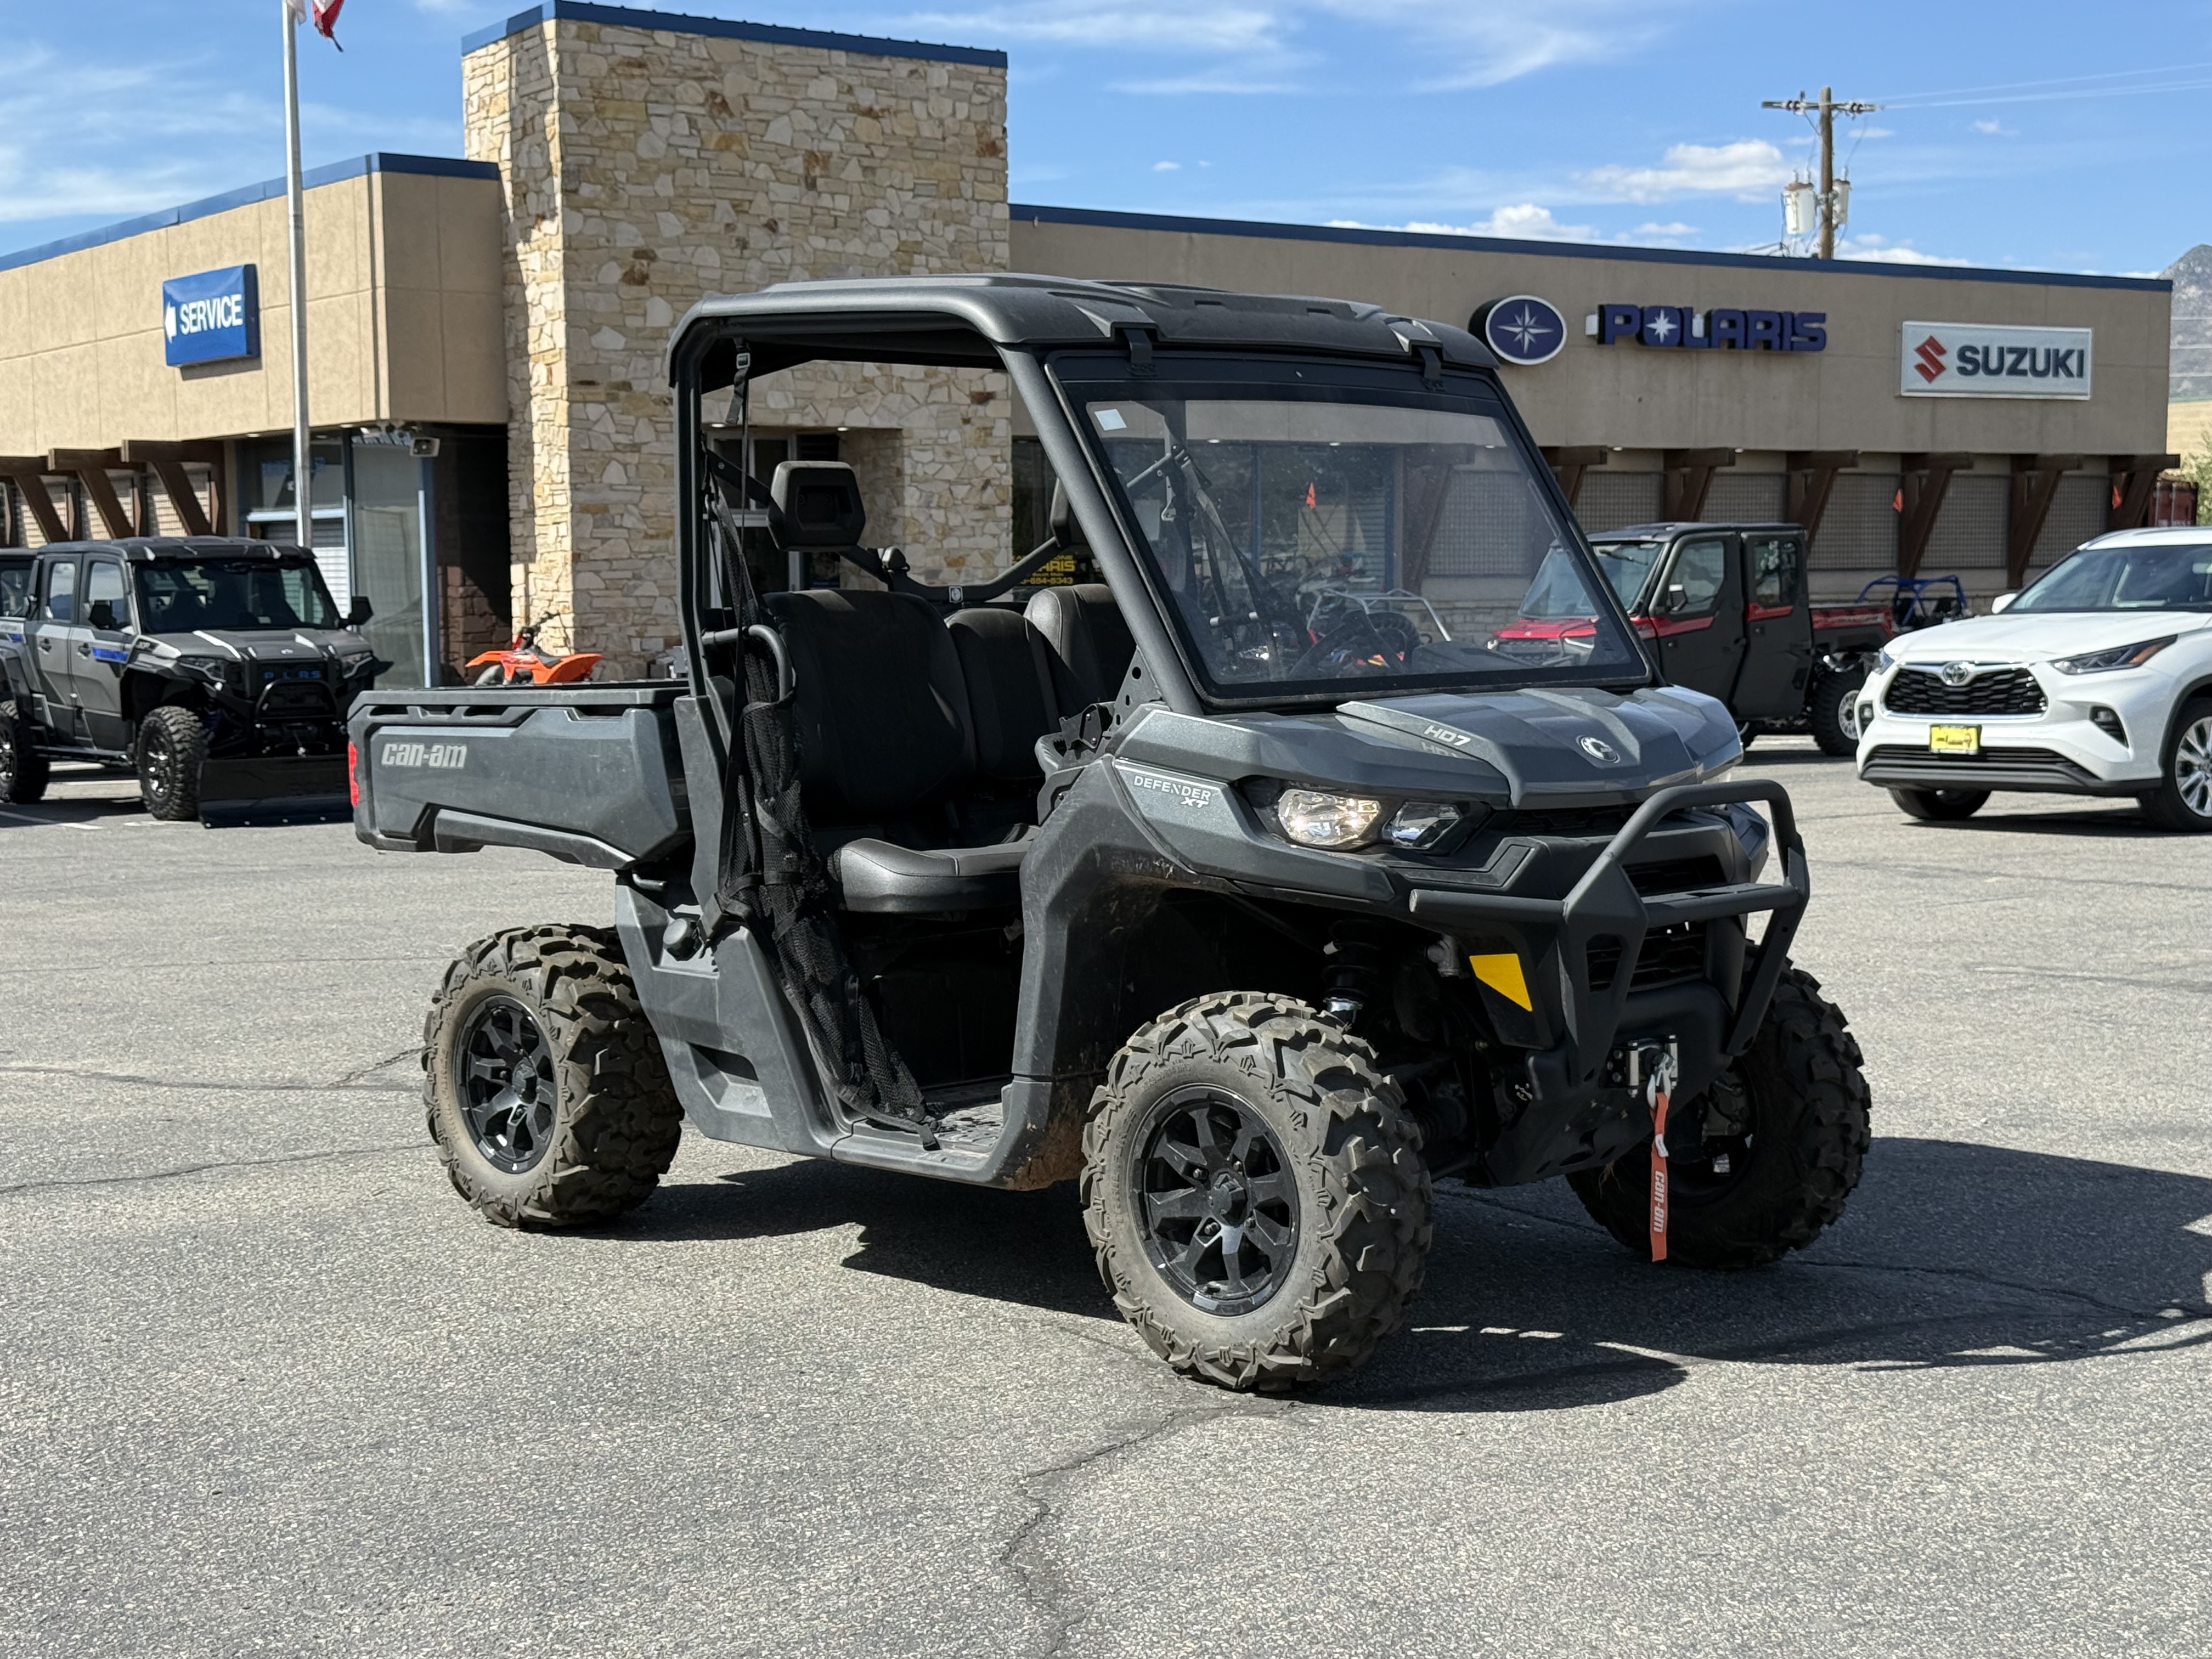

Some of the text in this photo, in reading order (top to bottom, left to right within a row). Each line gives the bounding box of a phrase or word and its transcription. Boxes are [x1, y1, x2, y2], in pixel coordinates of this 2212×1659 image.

[179, 294, 244, 335] SERVICE
[1598, 304, 1826, 352] POLARIS
[1956, 345, 2084, 379] SUZUKI
[1424, 725, 1471, 746] HD7
[381, 743, 467, 768] can-am
[1134, 775, 1211, 801] DEFENDER
[1180, 797, 1209, 808] XT
[1654, 1170, 1665, 1233] can-am
